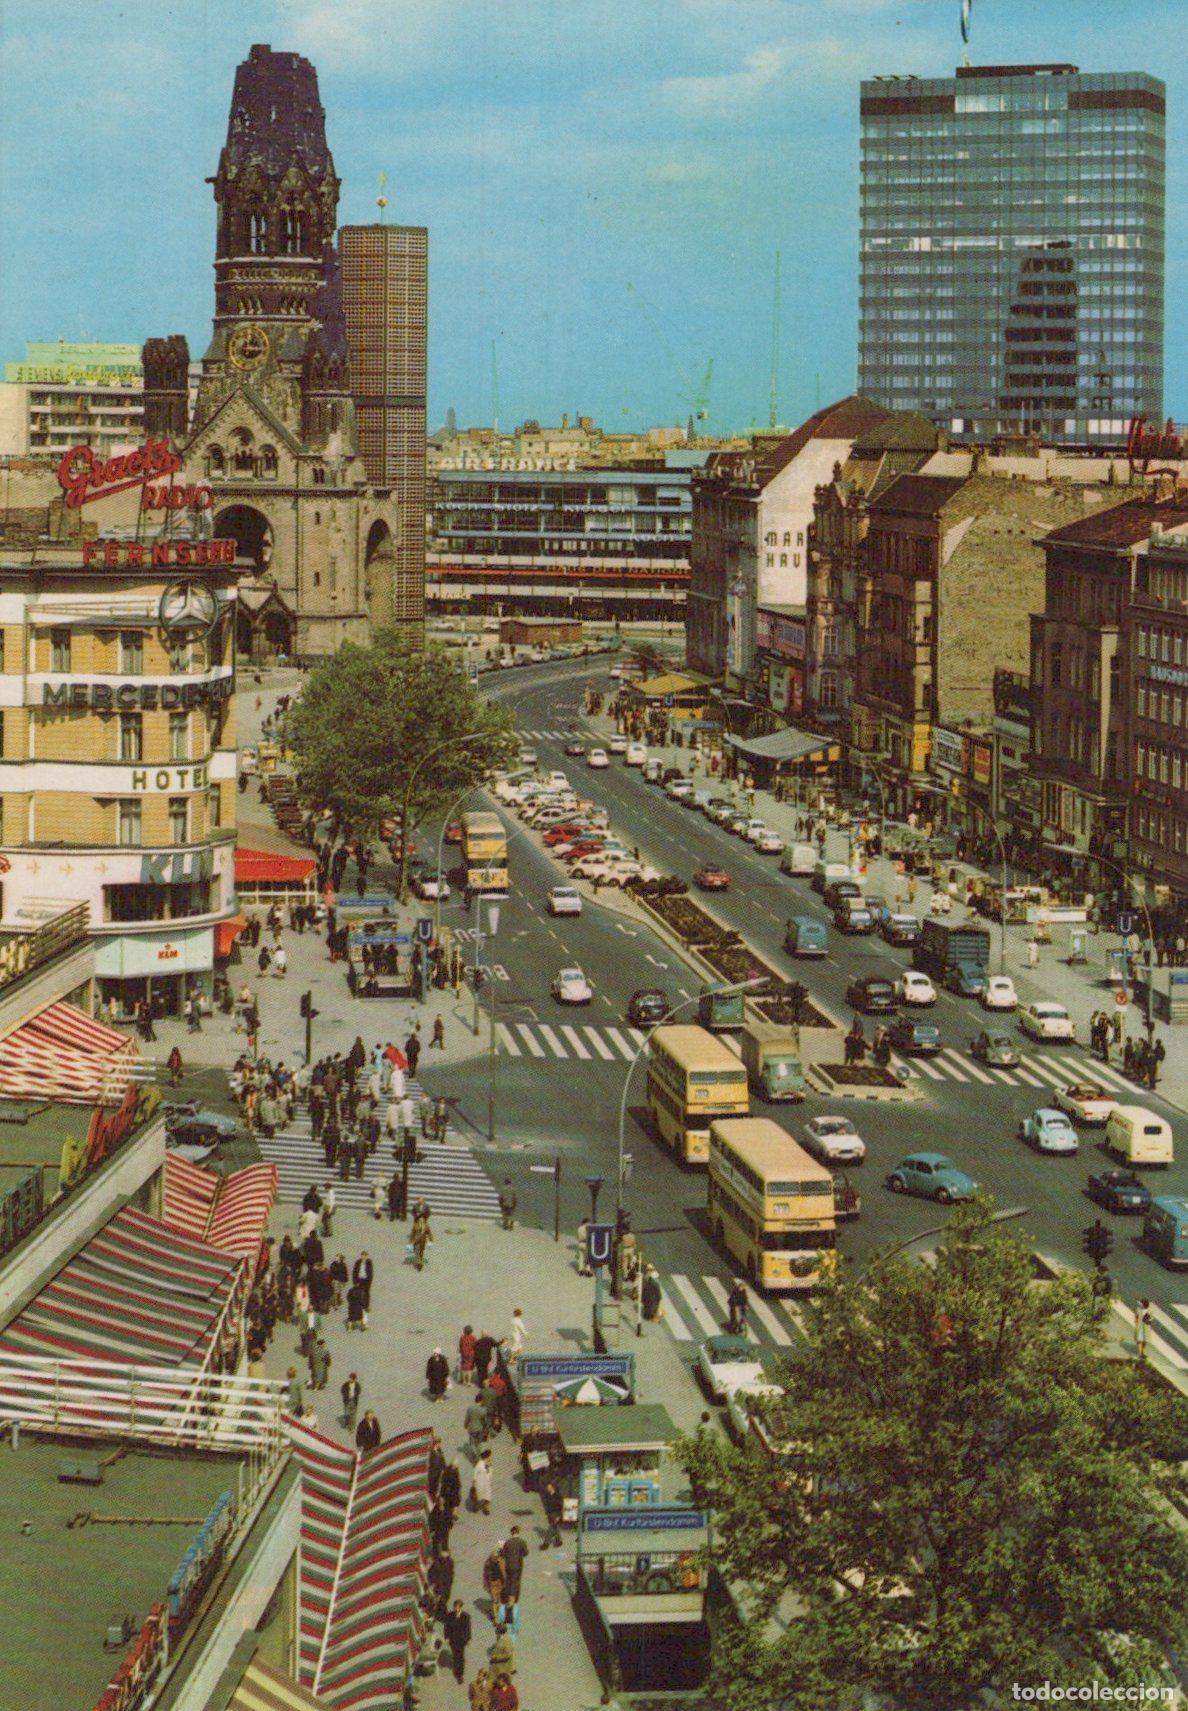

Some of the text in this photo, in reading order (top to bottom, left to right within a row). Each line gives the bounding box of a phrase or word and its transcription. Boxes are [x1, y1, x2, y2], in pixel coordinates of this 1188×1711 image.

[132, 766, 209, 790] HOTEL
[418, 921, 432, 940] U
[1120, 915, 1132, 933] U
[590, 1231, 609, 1259] U
